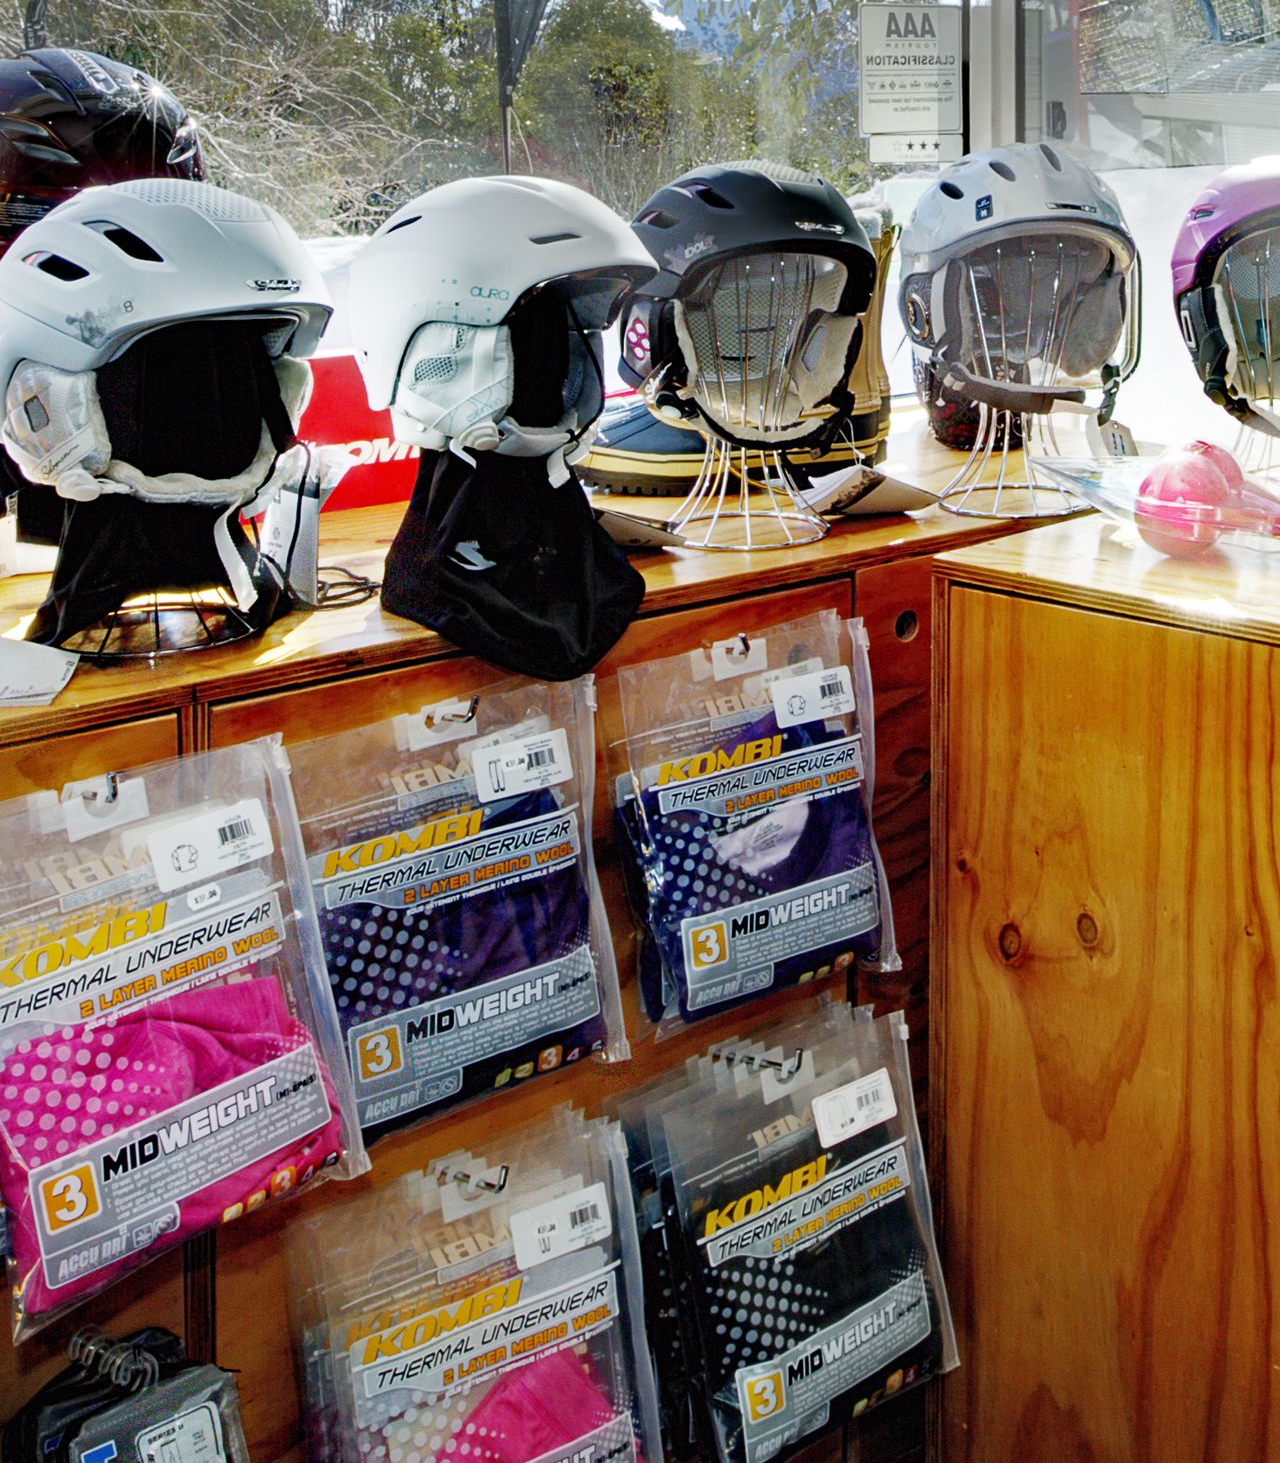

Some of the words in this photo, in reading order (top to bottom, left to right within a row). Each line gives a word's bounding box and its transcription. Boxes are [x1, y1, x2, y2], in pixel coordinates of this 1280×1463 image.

[657, 734, 784, 787] KOMBI
[671, 780, 754, 808] THERMAL
[753, 747, 856, 787] UNDERWEAR
[725, 800, 735, 813] 2
[737, 788, 776, 810] LAYER
[778, 777, 823, 799] MERINO
[826, 766, 860, 786] WOOL
[323, 808, 485, 879] KOMBI
[338, 860, 438, 903] THERMAL
[444, 819, 573, 870] UNDERWEAR
[403, 890, 418, 906] 2
[420, 872, 471, 901] LAYER
[473, 854, 532, 882] MERINO
[536, 841, 576, 865] WOOL
[697, 927, 721, 964] 3
[731, 882, 853, 939] MIDWEIGHT
[0, 963, 118, 1026] THERMAL
[124, 901, 273, 974] UNDERWEAR
[79, 1000, 96, 1019] 2
[98, 973, 159, 1013] LAYER
[161, 945, 228, 985] MERINO
[233, 925, 281, 957] WOOL
[406, 971, 561, 1045] MIDWEIGHT
[365, 1034, 394, 1074] 3
[102, 1076, 276, 1183] MIDWEIGHT
[51, 1173, 89, 1223] 3
[704, 1154, 827, 1239] KOMBI
[719, 1209, 798, 1260] THERMAL
[801, 1155, 898, 1218] UNDERWEAR
[772, 1238, 783, 1254] 2
[784, 1216, 823, 1248] LAYER
[826, 1193, 866, 1224] MERINO
[868, 1176, 904, 1201] WOOL
[362, 1276, 523, 1366] KOMBI
[377, 1335, 475, 1389] THERMAL
[480, 1280, 609, 1346] UNDERWEAR
[443, 1368, 455, 1387] 2
[458, 1347, 507, 1382] LAYER
[511, 1321, 569, 1357] MERINO
[572, 1303, 613, 1331] WOOL
[788, 1300, 898, 1387] MIDWEIGHT
[753, 1378, 778, 1416] 3
